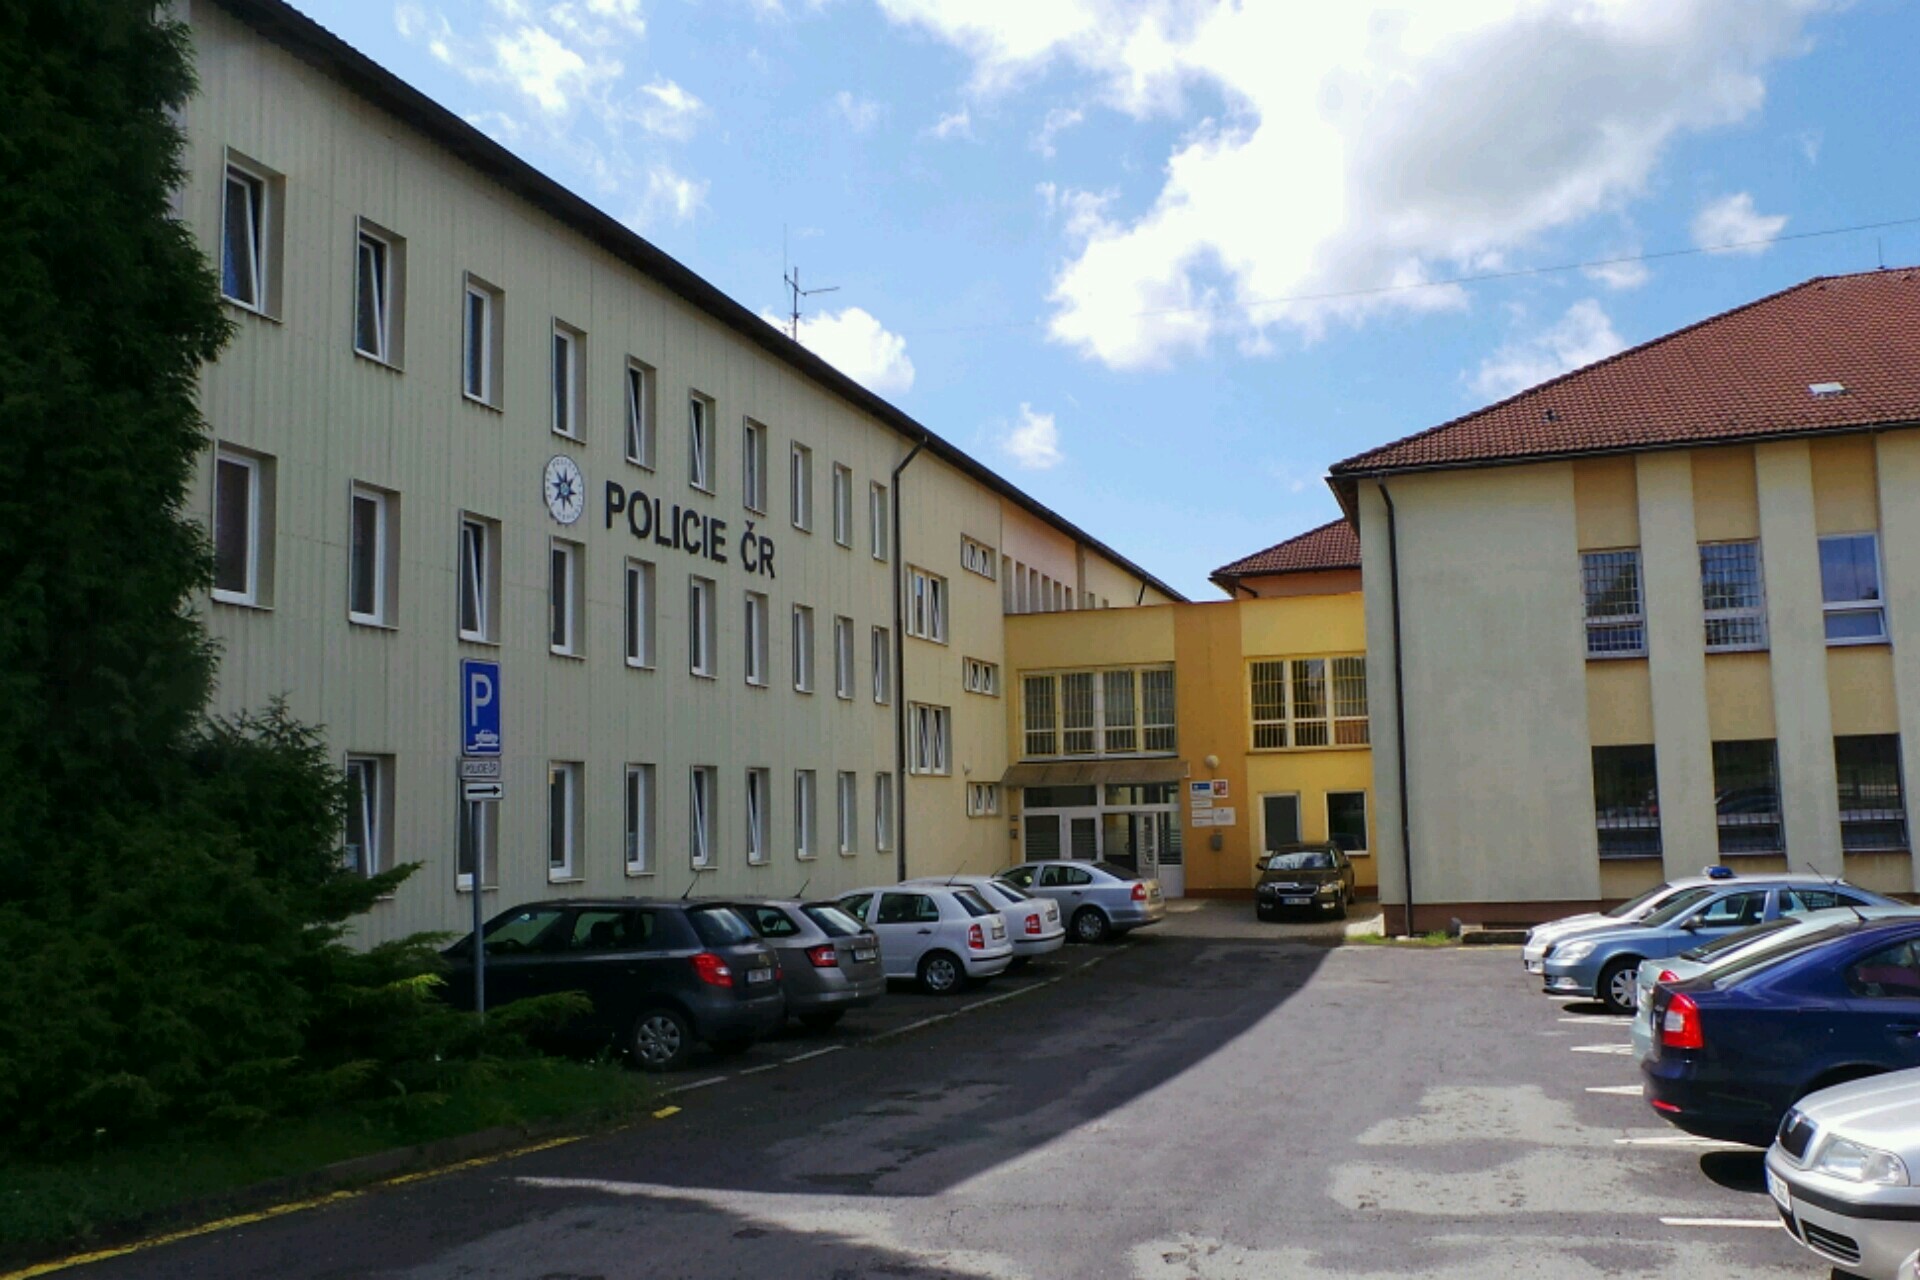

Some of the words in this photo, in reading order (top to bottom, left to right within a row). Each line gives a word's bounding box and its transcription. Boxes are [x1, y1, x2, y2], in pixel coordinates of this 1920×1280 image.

[606, 480, 727, 563] POLICIE
[740, 520, 776, 579] ČR
[471, 673, 492, 726] P
